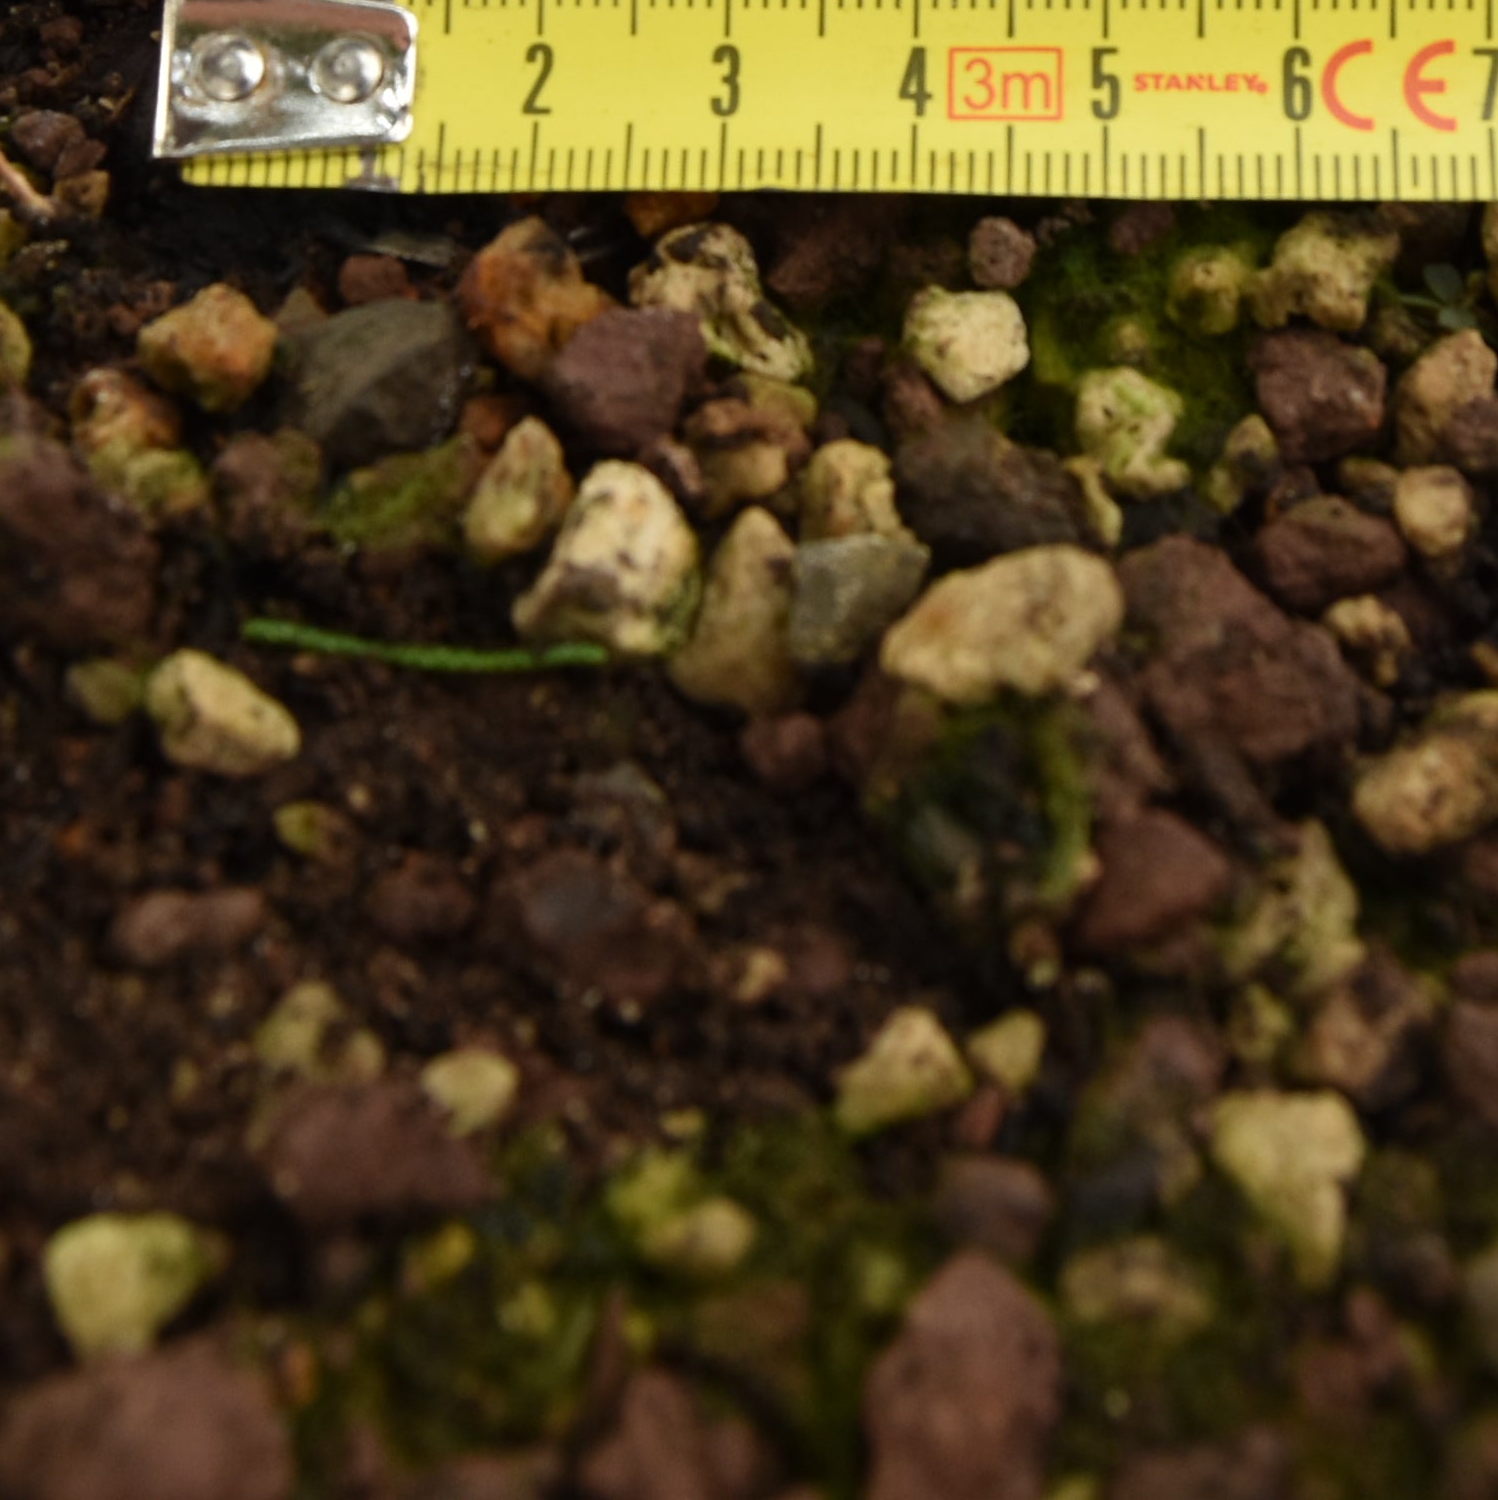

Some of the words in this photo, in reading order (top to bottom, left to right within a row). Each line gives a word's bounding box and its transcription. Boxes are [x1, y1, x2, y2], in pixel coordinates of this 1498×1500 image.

[521, 43, 554, 115] 2
[710, 44, 742, 116] 3
[898, 46, 933, 118] 4
[962, 58, 1054, 111] 3m
[1091, 47, 1121, 120] 5
[1282, 46, 1313, 121] 6
